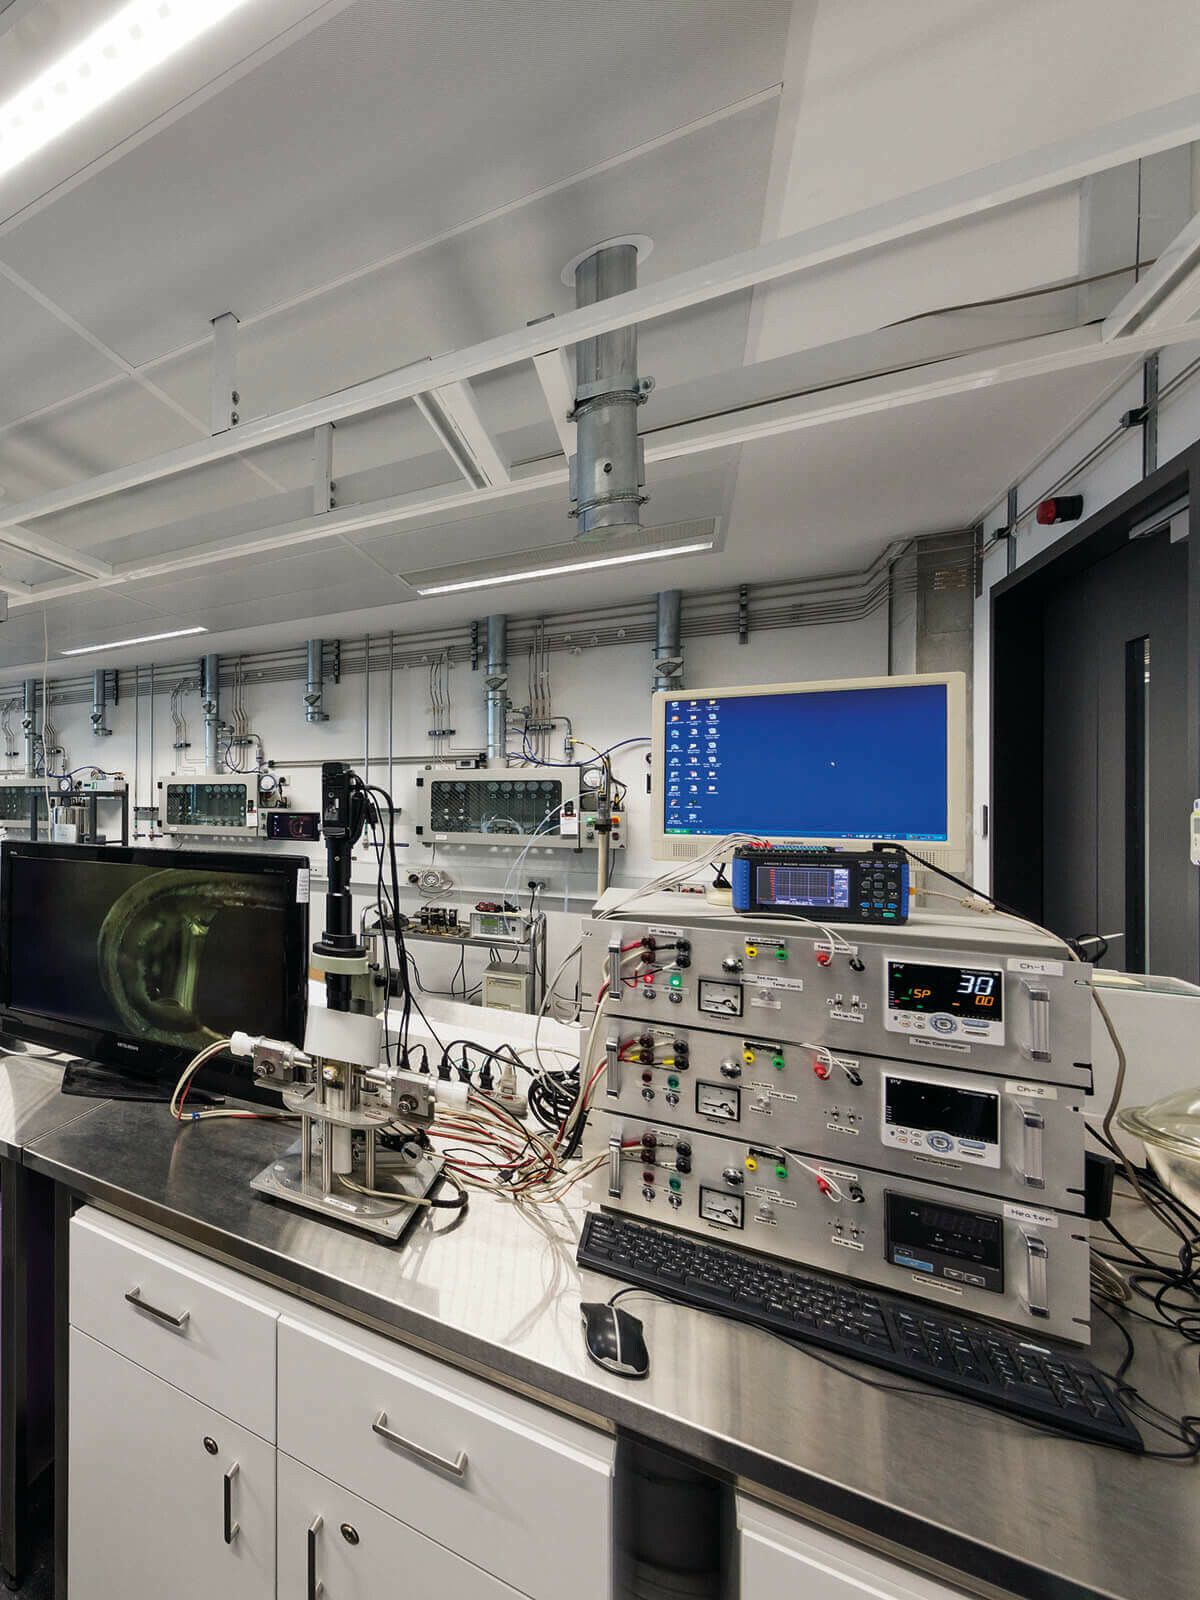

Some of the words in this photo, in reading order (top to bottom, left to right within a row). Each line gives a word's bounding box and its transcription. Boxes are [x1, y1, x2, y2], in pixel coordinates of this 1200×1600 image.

[1019, 963, 1046, 971] Ch-1
[913, 988, 931, 999] SP
[1016, 1085, 1045, 1095] Ch-2
[1011, 1209, 1051, 1222] Heater
